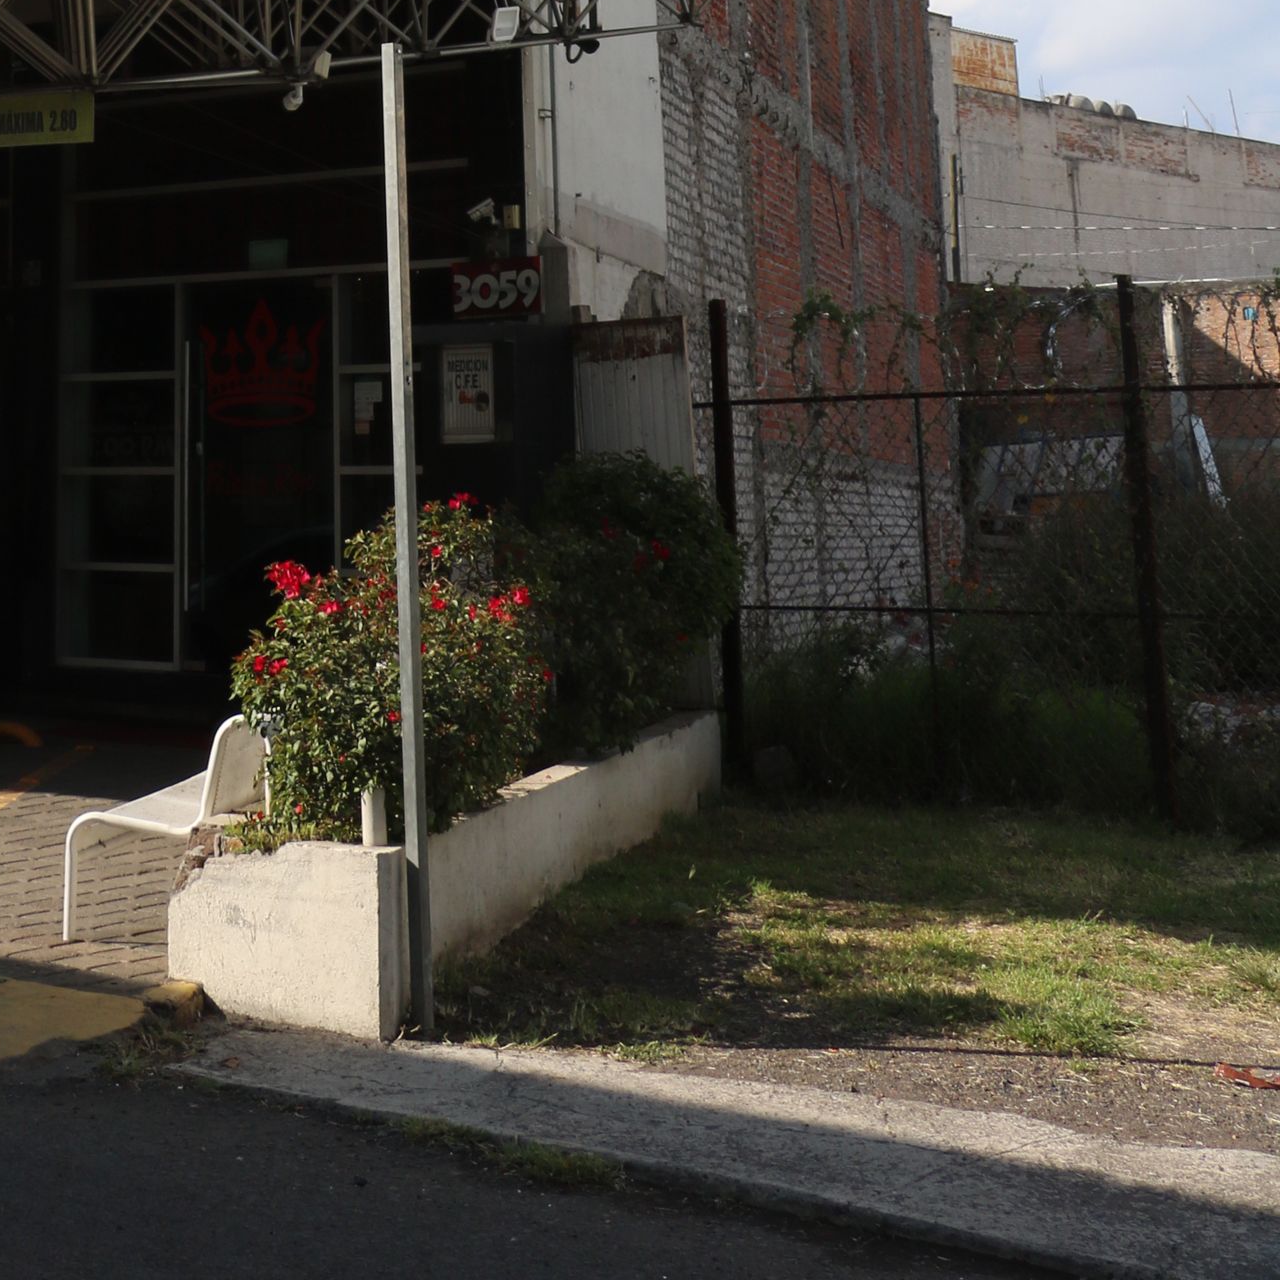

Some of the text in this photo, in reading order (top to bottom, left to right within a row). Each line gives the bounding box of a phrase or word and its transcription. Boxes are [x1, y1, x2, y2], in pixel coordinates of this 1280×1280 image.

[49, 109, 77, 132] 2.80
[452, 268, 540, 313] 3059
[447, 359, 488, 372] MEDICION
